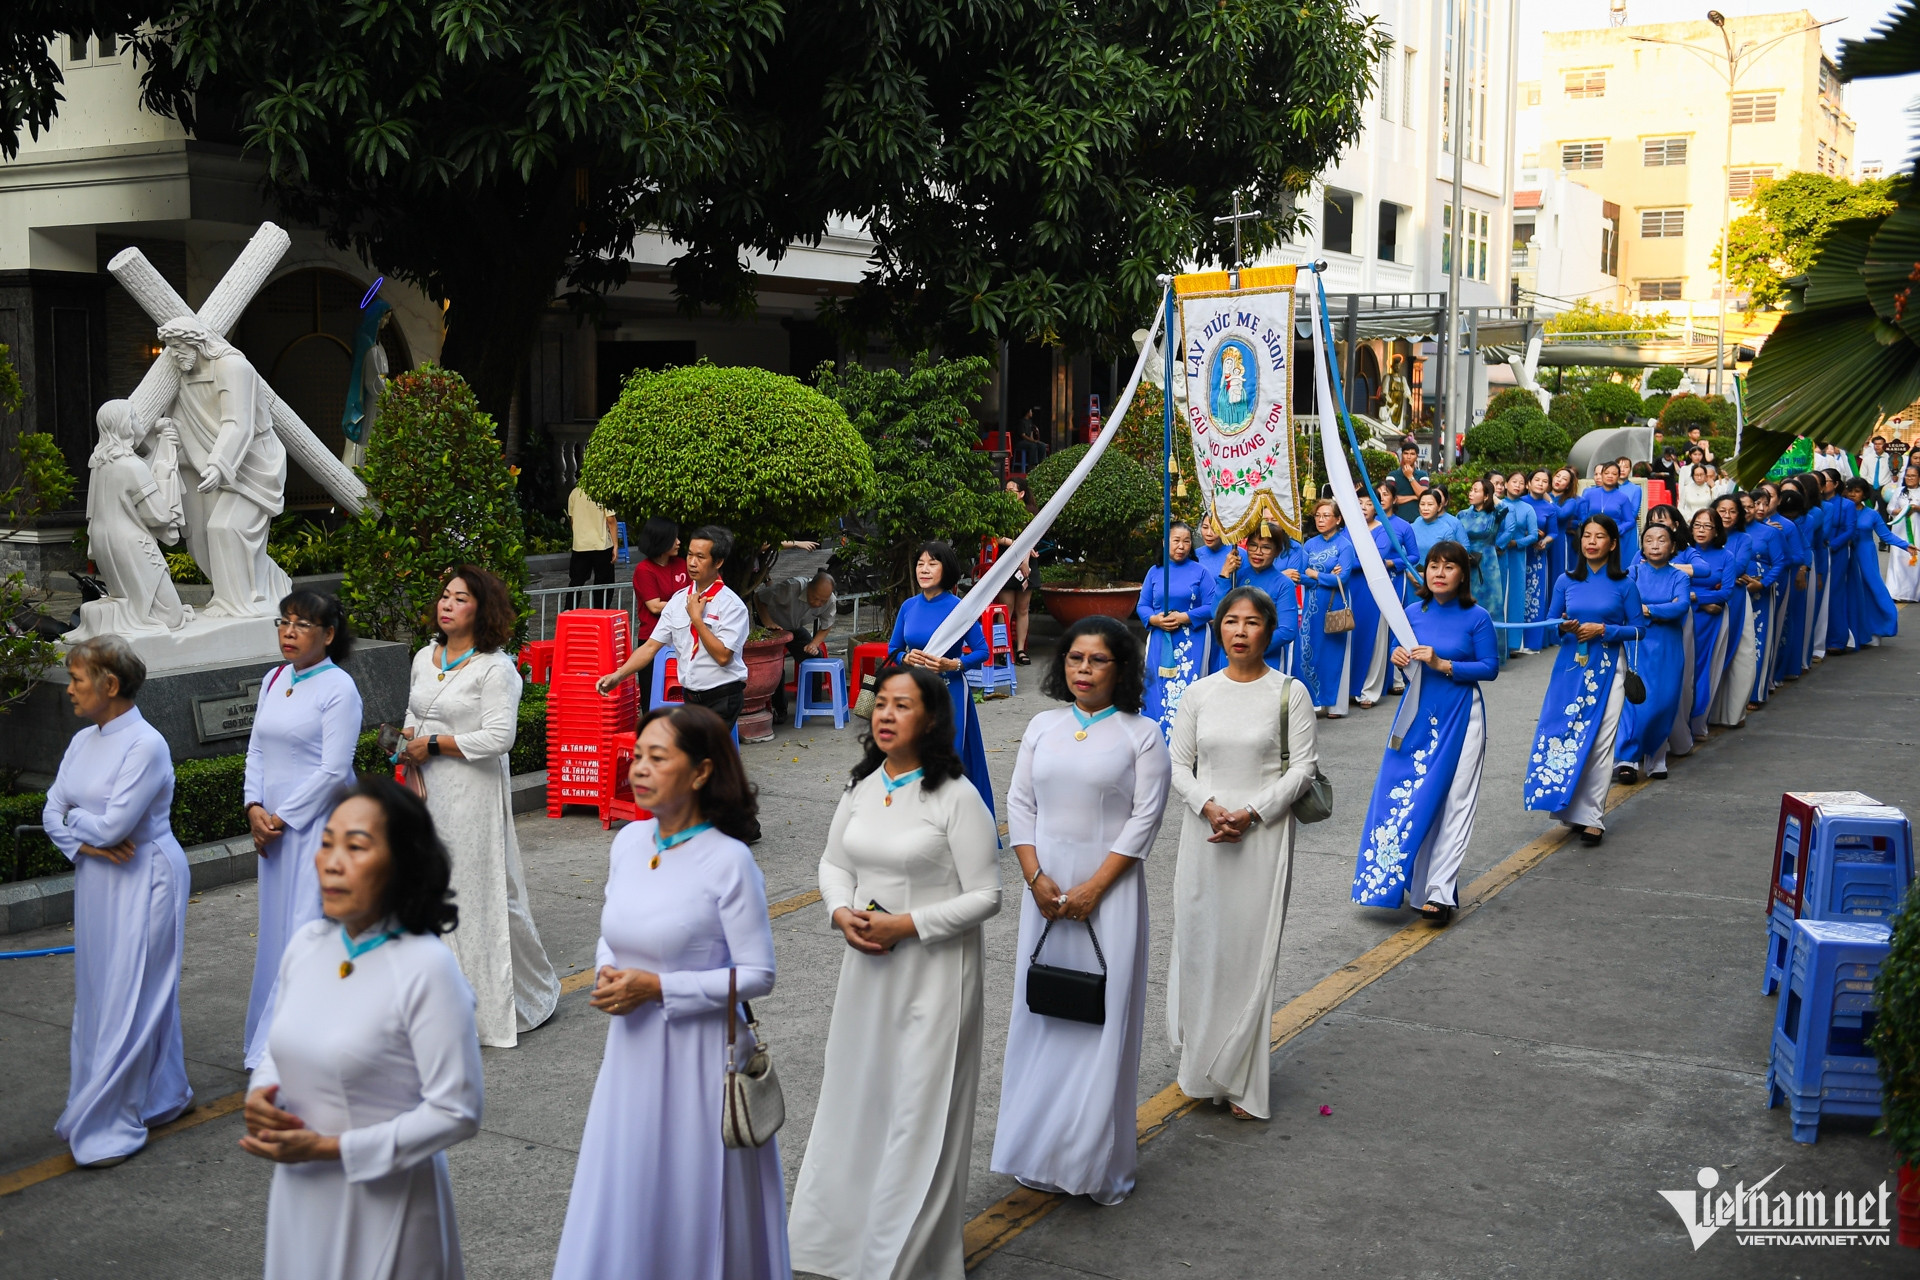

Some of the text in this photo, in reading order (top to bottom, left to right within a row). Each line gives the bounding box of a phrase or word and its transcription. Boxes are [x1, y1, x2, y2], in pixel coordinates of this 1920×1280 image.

[1188, 339, 1205, 378] LẠY
[1236, 311, 1260, 335] MẸ
[1189, 406, 1208, 435] CẦU
[1222, 433, 1265, 459] CHÚNG
[1265, 403, 1283, 433] CON
